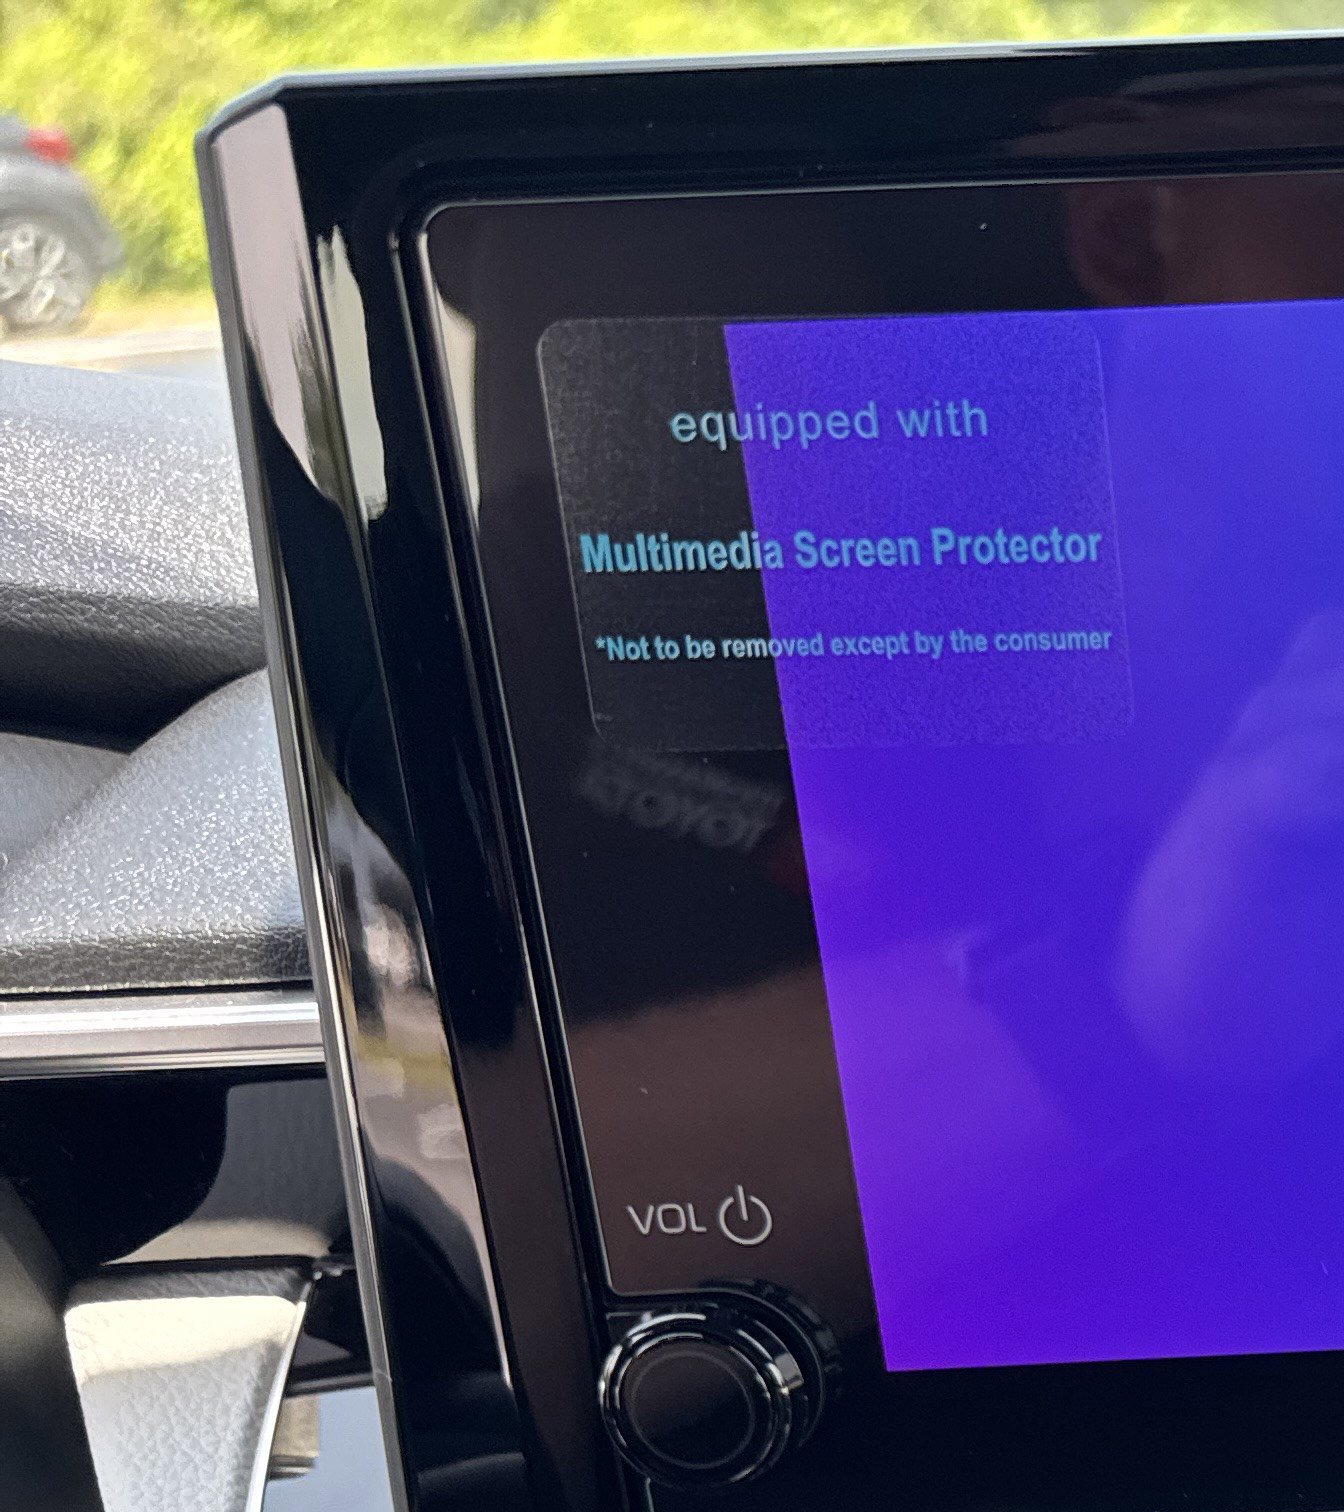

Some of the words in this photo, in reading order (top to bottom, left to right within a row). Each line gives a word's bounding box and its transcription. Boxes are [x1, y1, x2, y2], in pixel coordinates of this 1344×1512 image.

[669, 401, 879, 451] equipped
[896, 399, 988, 439] with
[579, 530, 784, 573] Multimedia
[793, 529, 921, 569] Screen
[930, 526, 1102, 566] Protector
[653, 634, 680, 661] to
[685, 634, 716, 660] be
[722, 632, 824, 660] removed
[830, 630, 910, 661] except
[913, 628, 944, 660] by
[949, 628, 988, 654] the
[994, 629, 1112, 653] consumer
[626, 1201, 708, 1236] VOL
